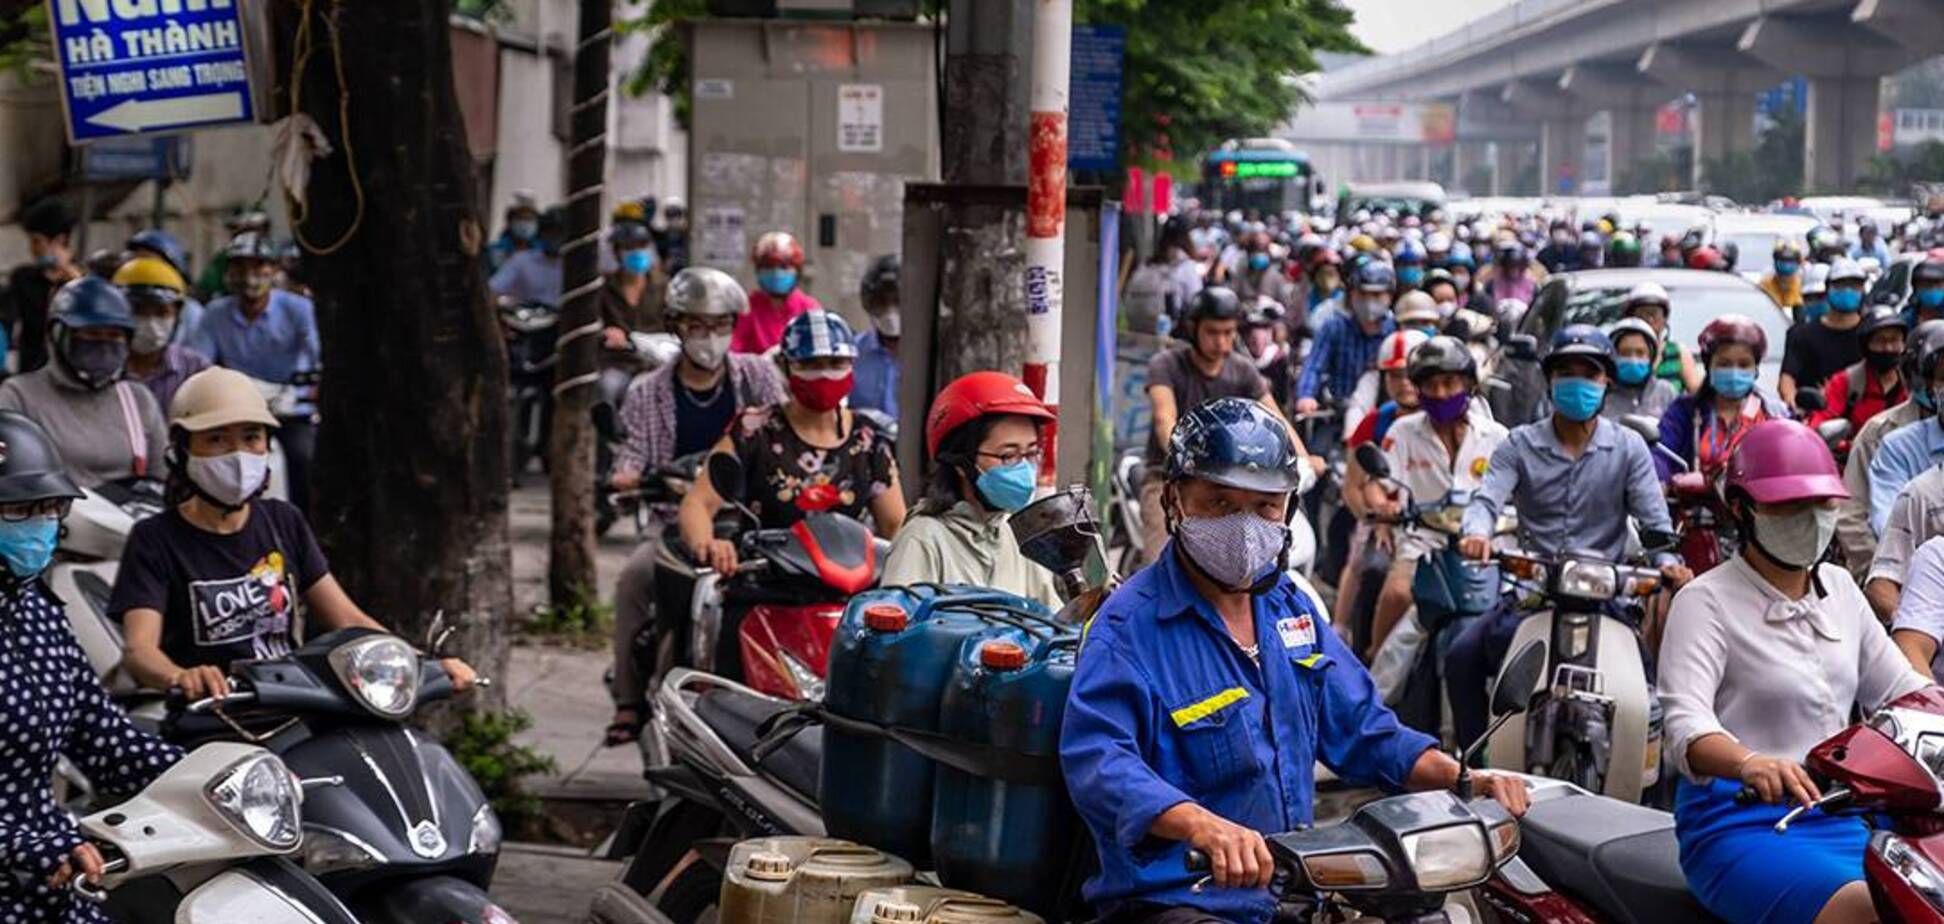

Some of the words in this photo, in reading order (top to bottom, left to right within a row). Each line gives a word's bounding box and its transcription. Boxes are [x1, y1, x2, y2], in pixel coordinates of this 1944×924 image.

[67, 28, 114, 63] HÀ
[121, 20, 238, 57] THÀNH
[148, 66, 192, 90] SANG
[199, 581, 266, 626] LOVE
